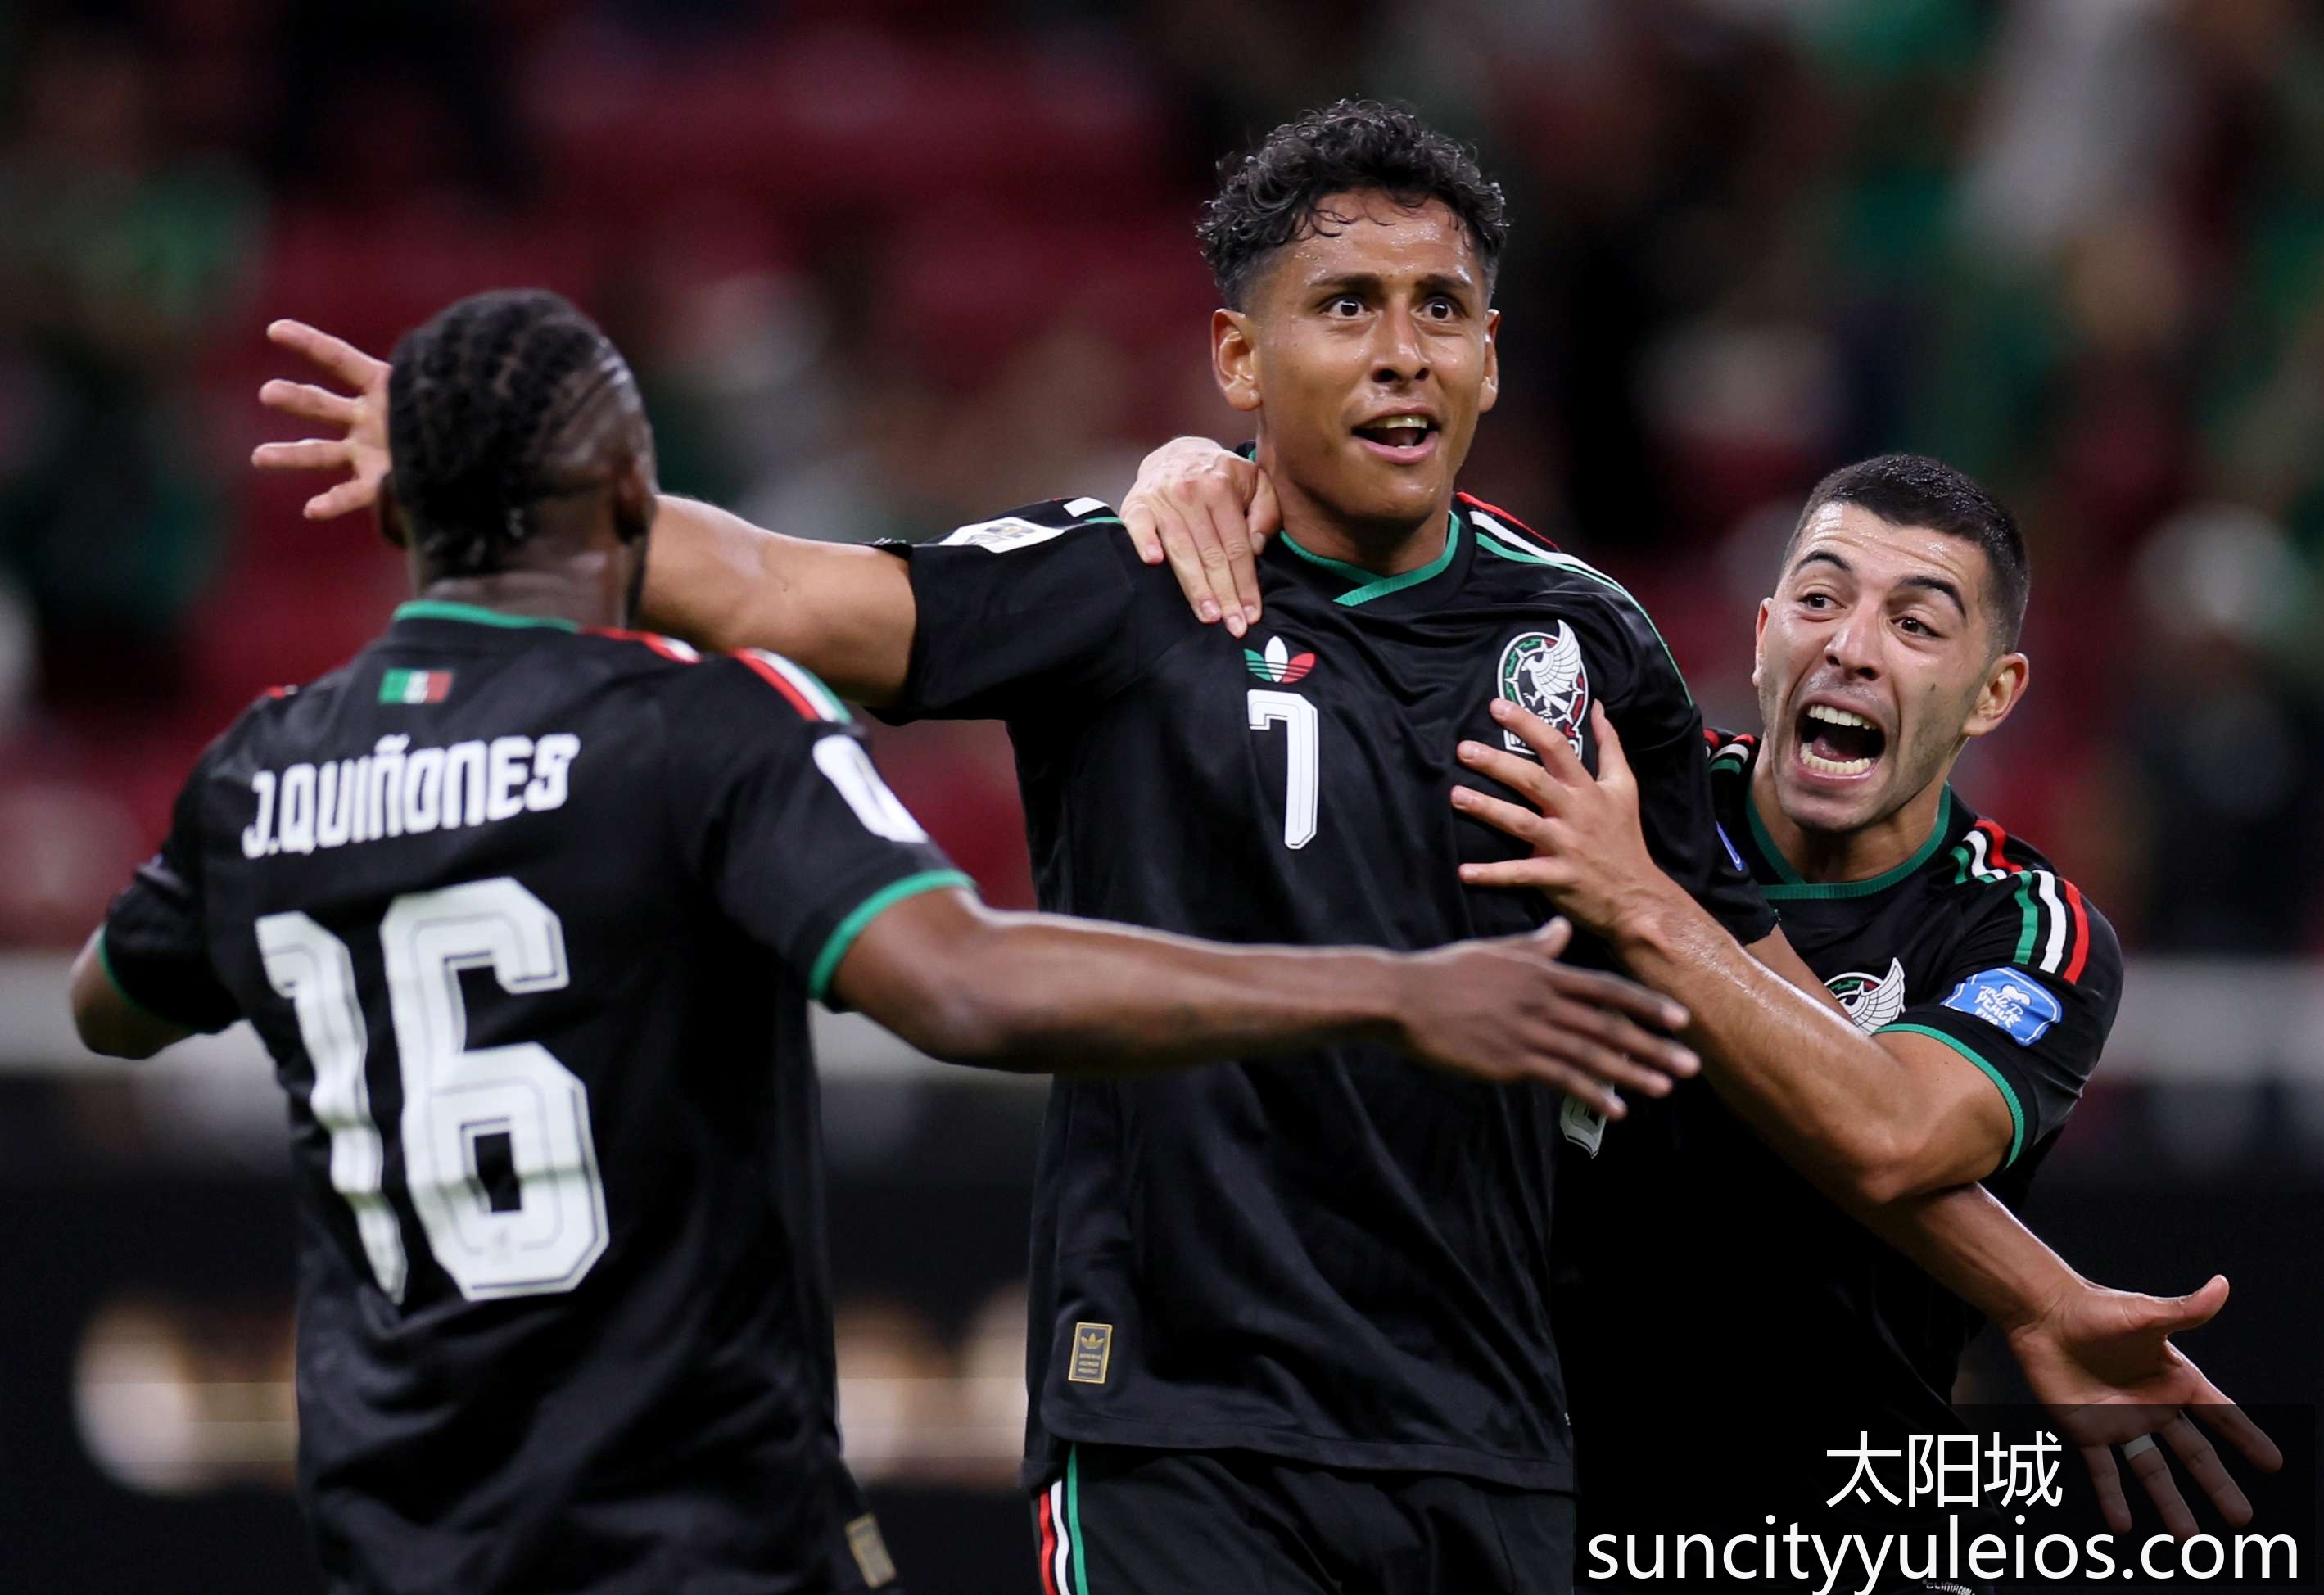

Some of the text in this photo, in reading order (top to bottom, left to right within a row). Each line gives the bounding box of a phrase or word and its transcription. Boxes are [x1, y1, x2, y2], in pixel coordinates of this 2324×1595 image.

[242, 733, 581, 859] J.QUIÑONES
[1247, 689, 1319, 850] 7
[255, 876, 609, 1303] 16
